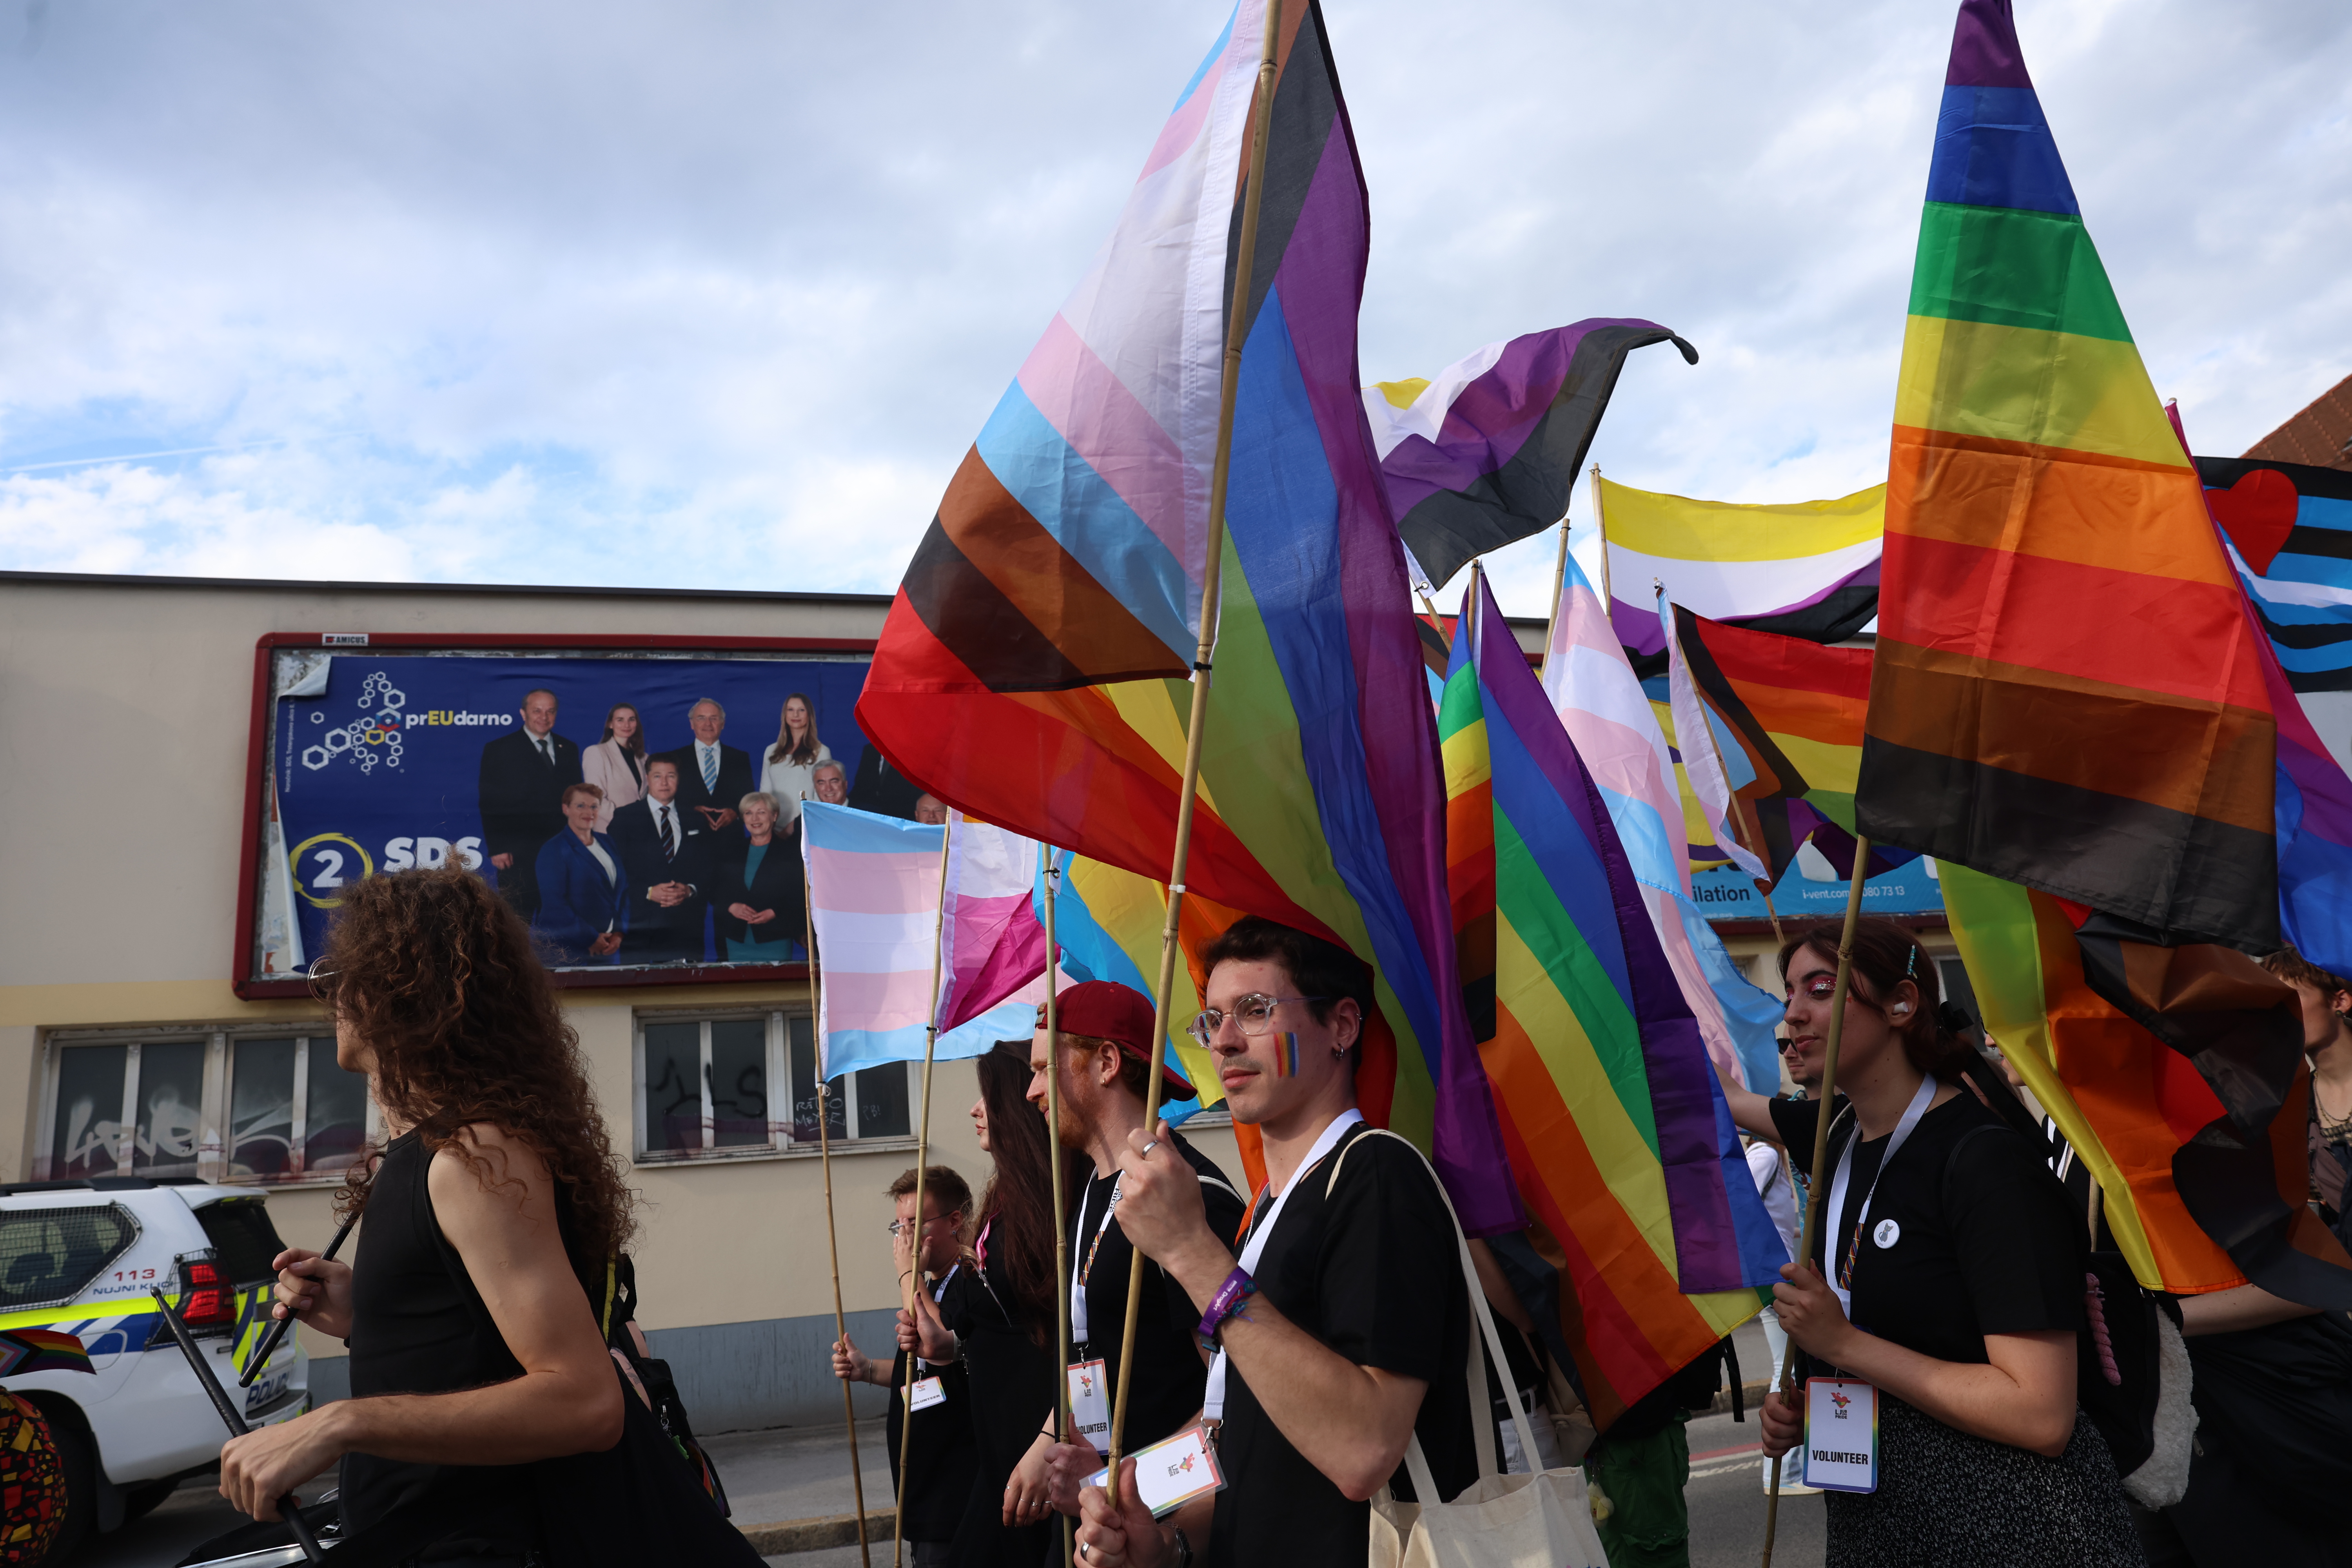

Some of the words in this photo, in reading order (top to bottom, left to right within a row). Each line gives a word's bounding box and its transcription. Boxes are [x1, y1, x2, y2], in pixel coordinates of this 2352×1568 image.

[405, 710, 513, 729] prEUdarno
[383, 836, 483, 873] SDS
[312, 849, 344, 888] 2
[1691, 885, 1751, 902] ilation
[1803, 889, 1849, 899] i-vent.com
[1883, 886, 1893, 896] 73
[1895, 886, 1905, 896] 13
[1109, 1188, 1120, 1213] RIDE
[114, 1269, 155, 1282] 113
[93, 1284, 136, 1295] NUJNI
[1213, 1291, 1228, 1311] DrogArt
[1812, 1450, 1868, 1465] VOLUNTEER
